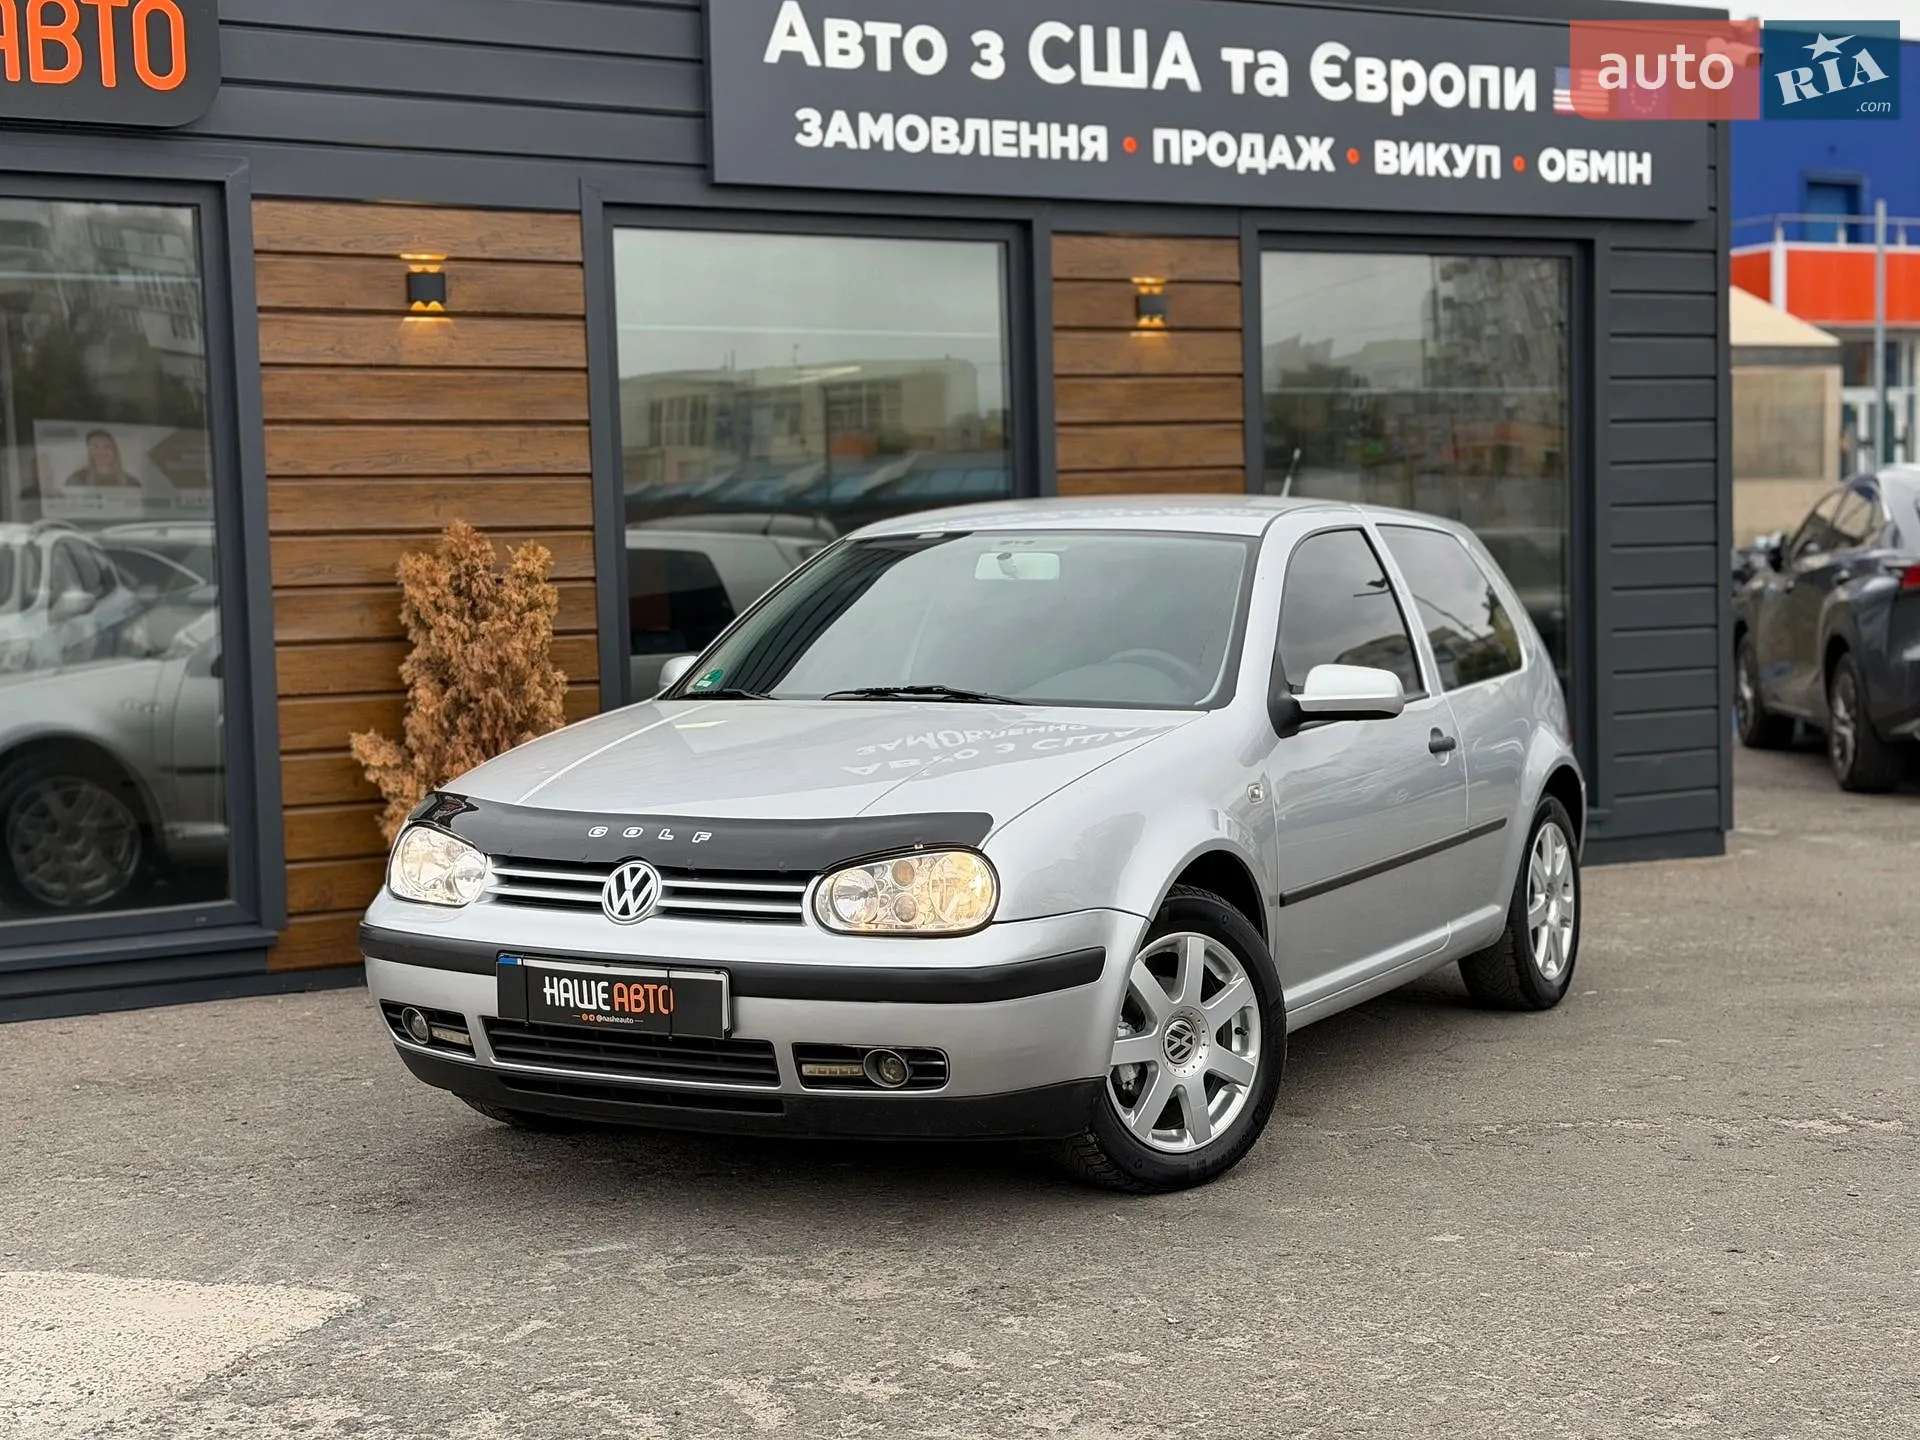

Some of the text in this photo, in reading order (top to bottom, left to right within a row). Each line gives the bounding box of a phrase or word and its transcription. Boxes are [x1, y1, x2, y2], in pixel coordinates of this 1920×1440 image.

[762, 0, 1537, 117] Авто з США та Європи
[794, 107, 1653, 187] ЗАМОВЛЕННЯ ПРОДАЖ ВИКУП ОБМІН
[587, 825, 713, 844] GOLF
